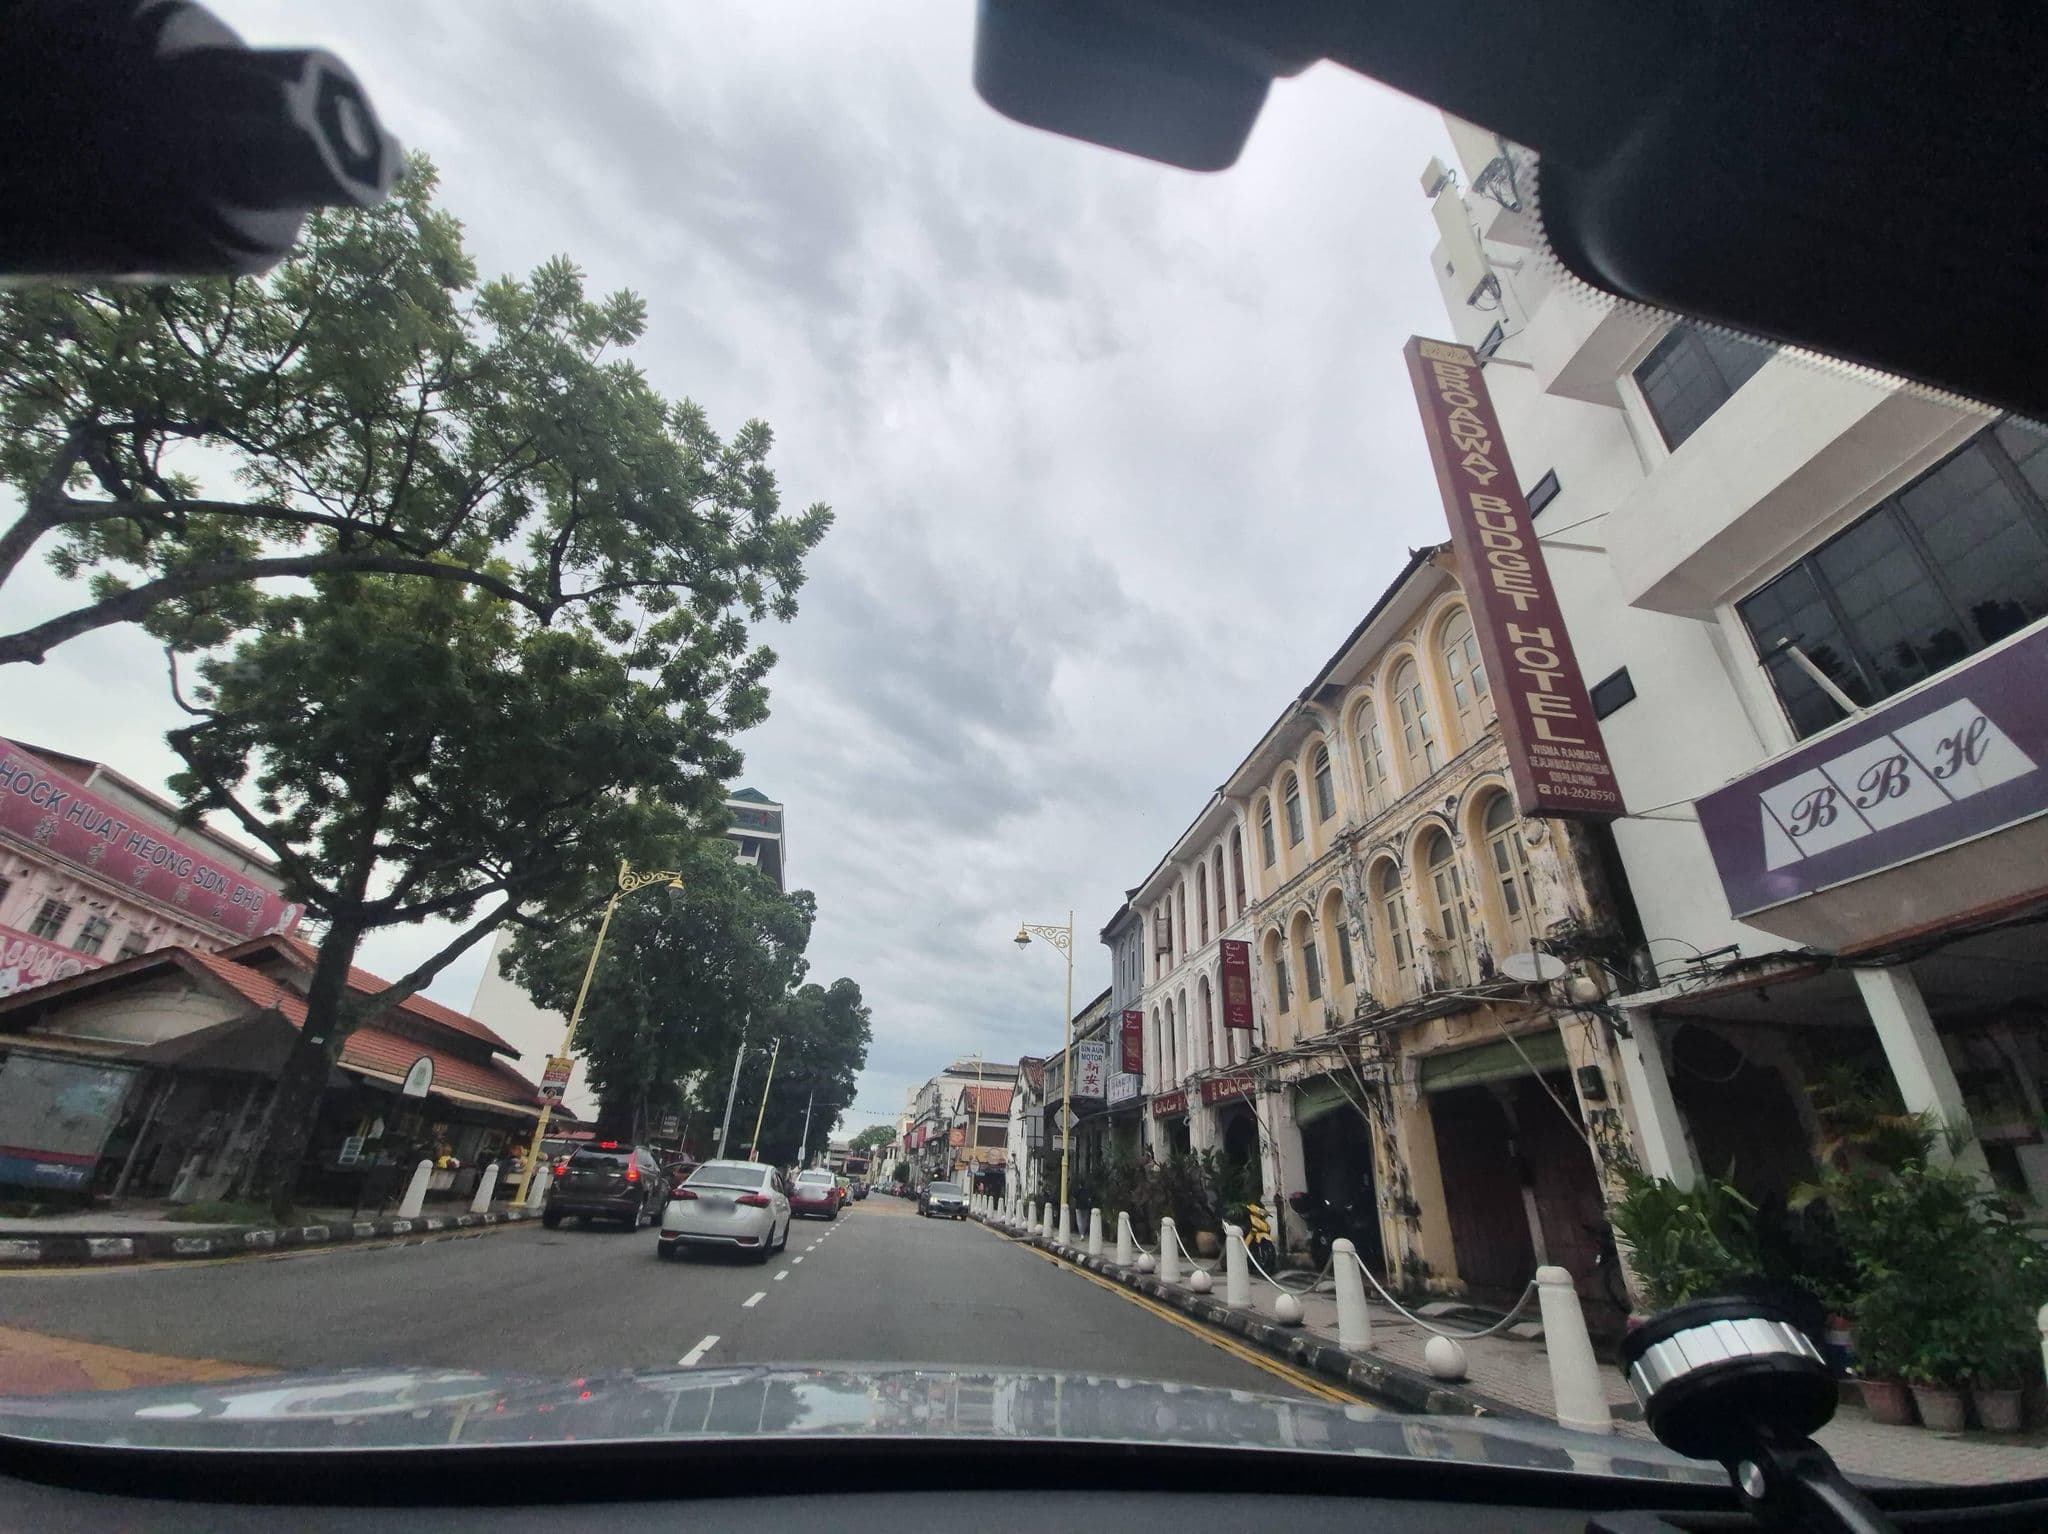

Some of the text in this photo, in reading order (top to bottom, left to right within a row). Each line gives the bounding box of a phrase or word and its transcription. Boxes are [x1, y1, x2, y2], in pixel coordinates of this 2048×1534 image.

[1432, 360, 1499, 486] BROADWAY
[1469, 492, 1541, 612] BUDGET
[1506, 622, 1586, 745] HOTEL
[0, 760, 69, 814] HOCK
[65, 799, 129, 845] HUAT
[124, 831, 192, 878] HEONG
[1553, 785, 1616, 801] 04-2628550
[1081, 1053, 1103, 1062] MOTOR
